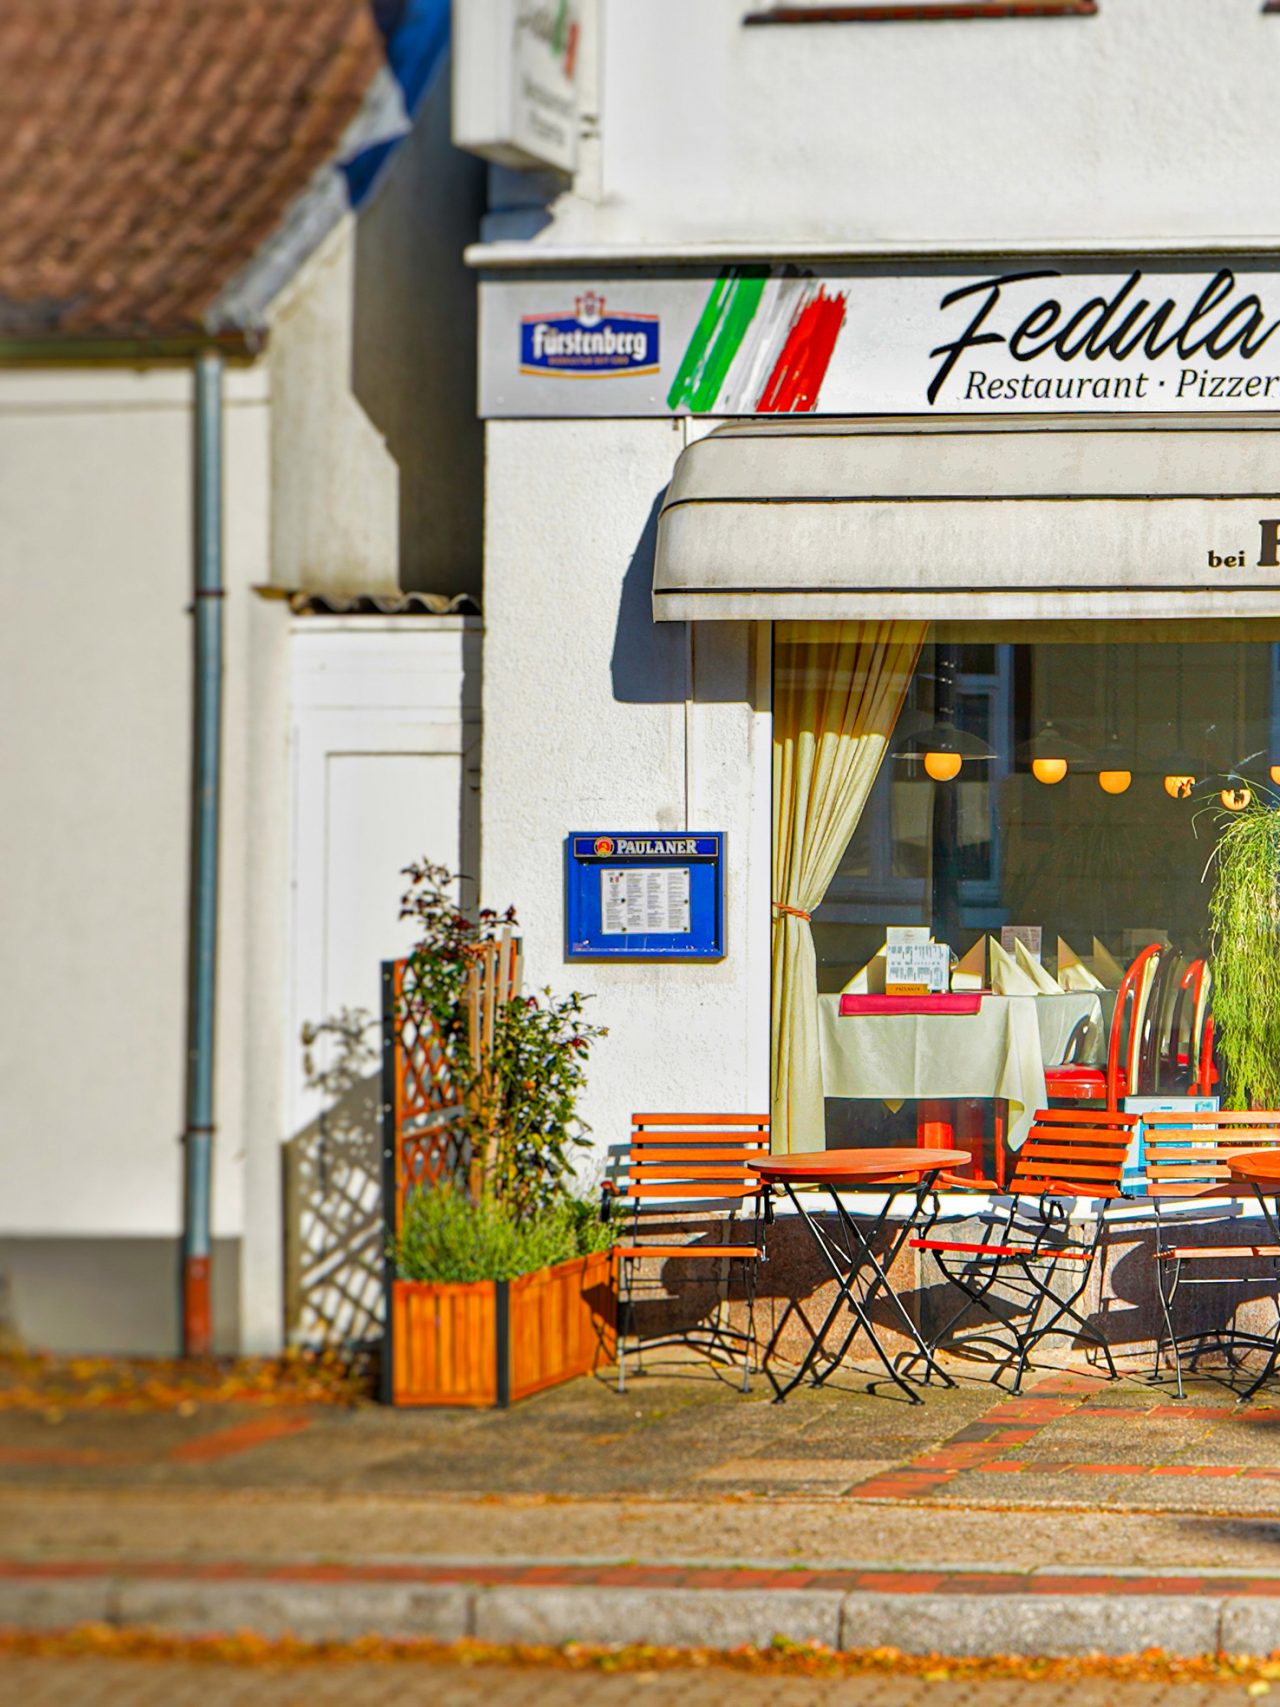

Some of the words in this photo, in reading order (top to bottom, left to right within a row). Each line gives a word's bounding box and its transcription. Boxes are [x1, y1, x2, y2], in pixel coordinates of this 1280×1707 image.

[964, 370, 1149, 400] Restaurant
[1207, 550, 1246, 569] bei
[617, 839, 698, 855] PAULANER
